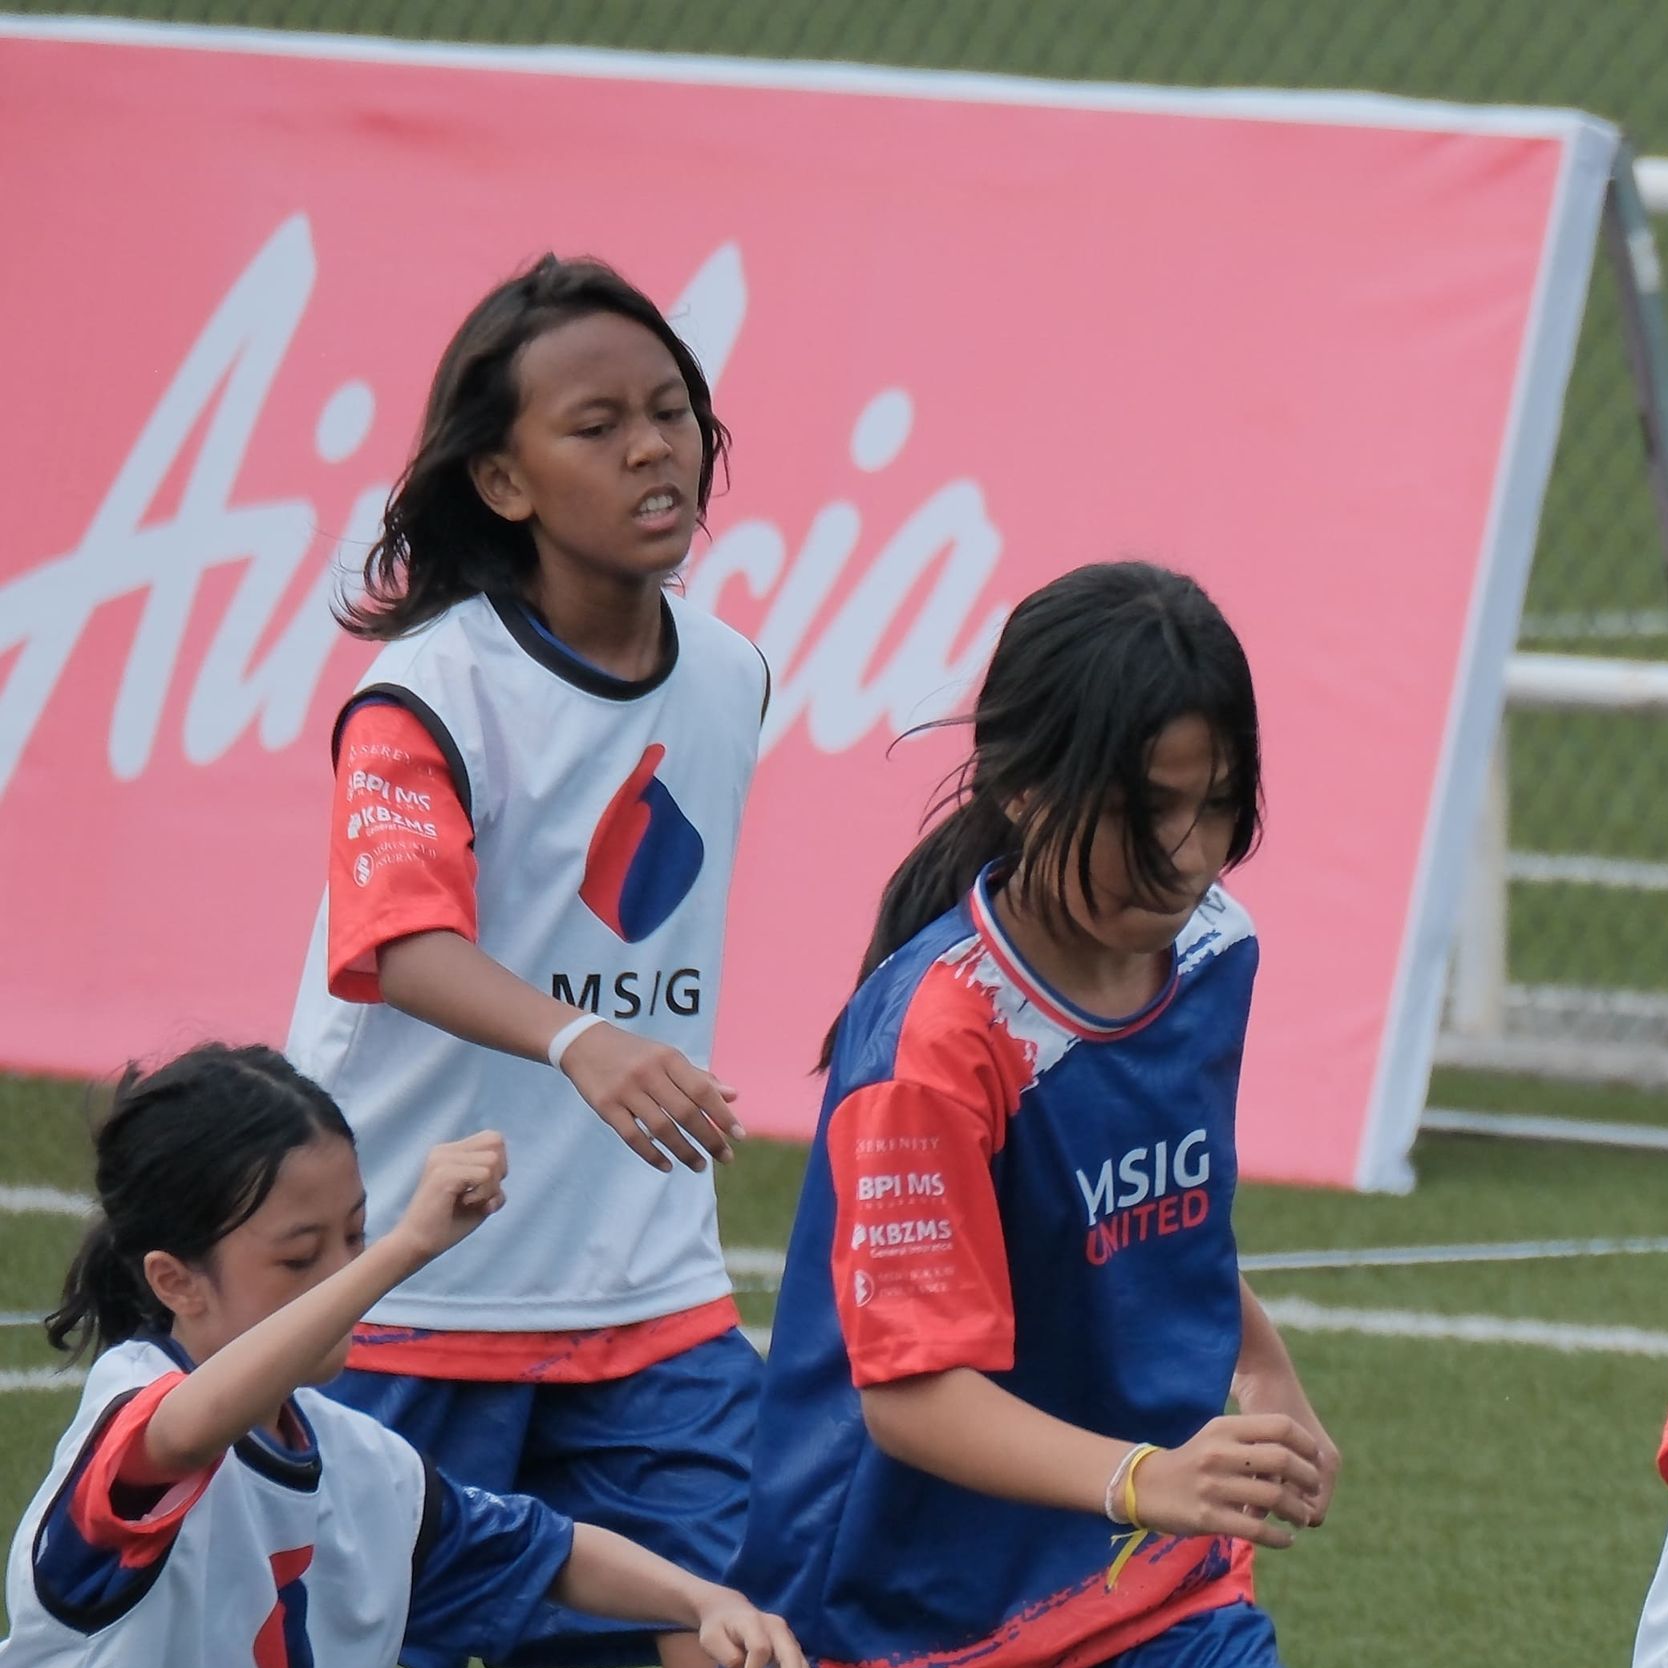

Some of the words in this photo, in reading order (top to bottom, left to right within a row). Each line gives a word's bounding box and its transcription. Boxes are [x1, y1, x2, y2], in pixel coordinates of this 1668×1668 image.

[0, 210, 1008, 800] Airia
[394, 786, 432, 812] MS
[361, 806, 438, 837] KBZMS
[552, 968, 700, 1020] MSIG
[858, 1174, 902, 1201] BPI
[906, 1171, 946, 1197] MS
[1076, 1128, 1210, 1226] MSIG
[869, 1219, 952, 1248] KBZMS
[1086, 1188, 1209, 1266] UNITED
